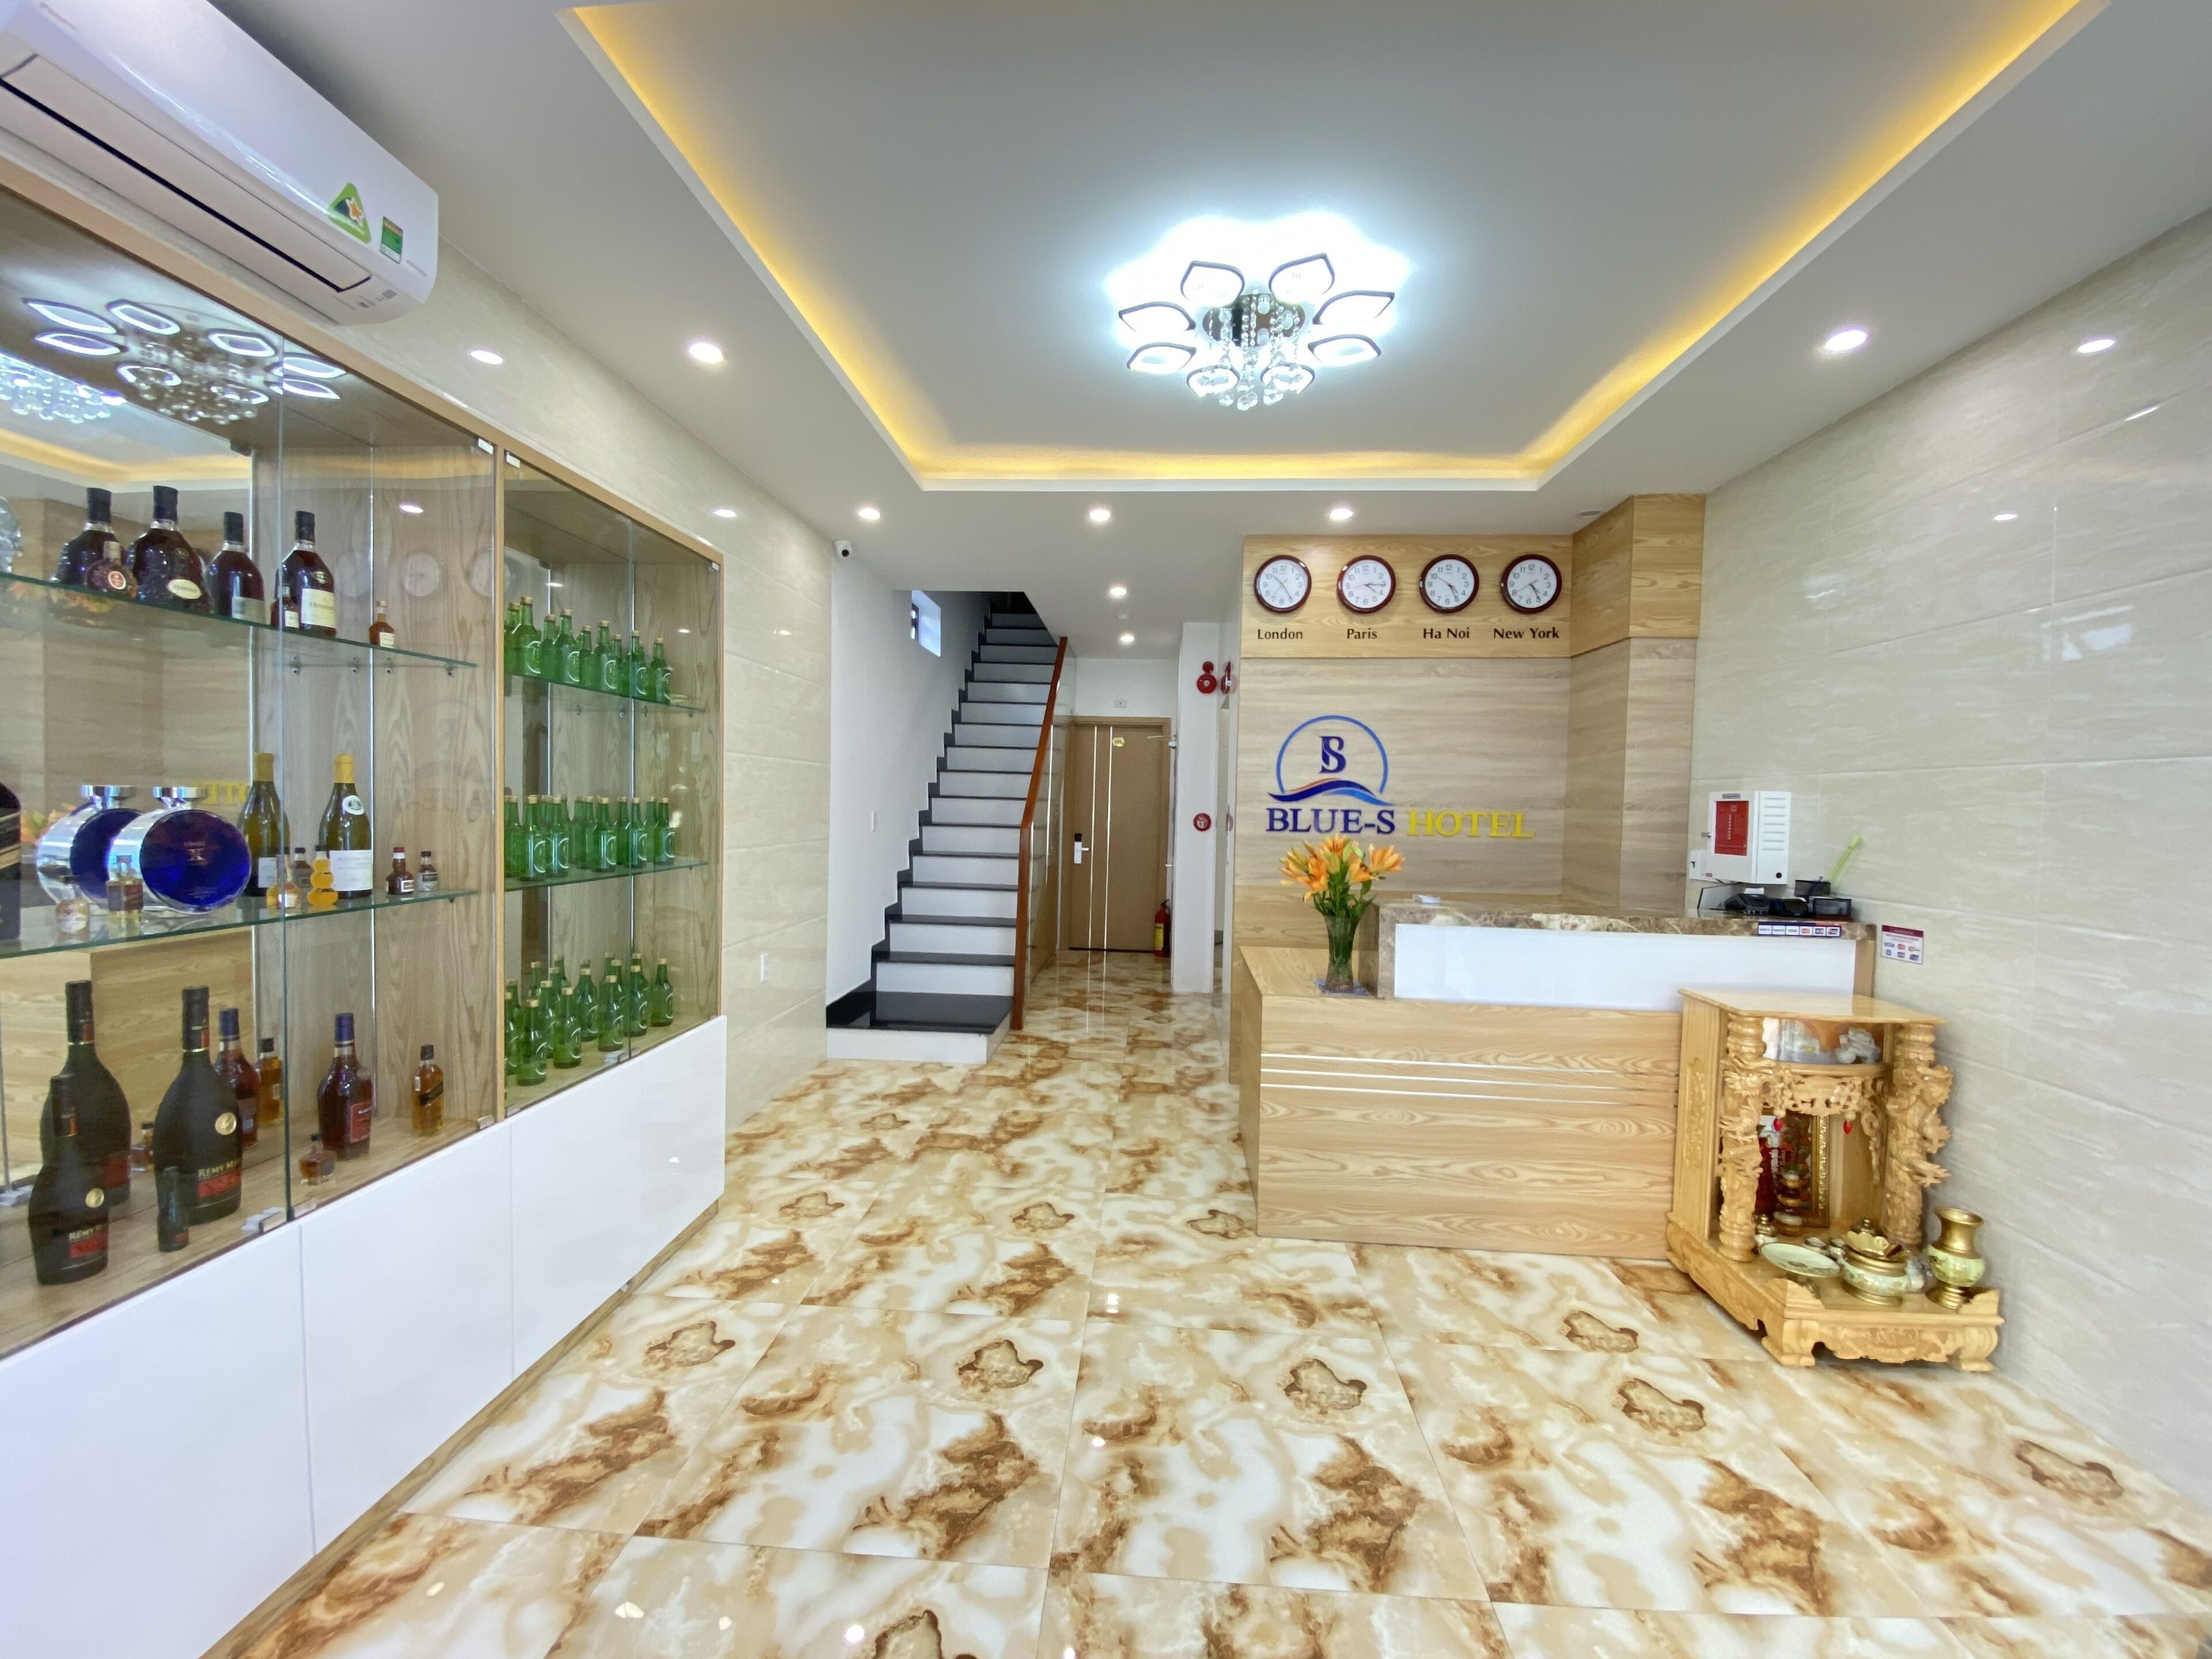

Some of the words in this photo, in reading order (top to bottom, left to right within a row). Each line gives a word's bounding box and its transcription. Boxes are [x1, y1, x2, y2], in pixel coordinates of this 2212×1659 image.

[1257, 628, 1303, 639] London
[1347, 628, 1377, 639] Paris
[1423, 628, 1441, 639] Ha
[1446, 627, 1469, 639] Noi
[1494, 628, 1524, 639] New
[1529, 627, 1559, 639] York
[1265, 808, 1396, 835] BLUE-S
[1406, 809, 1536, 838] HOTEL
